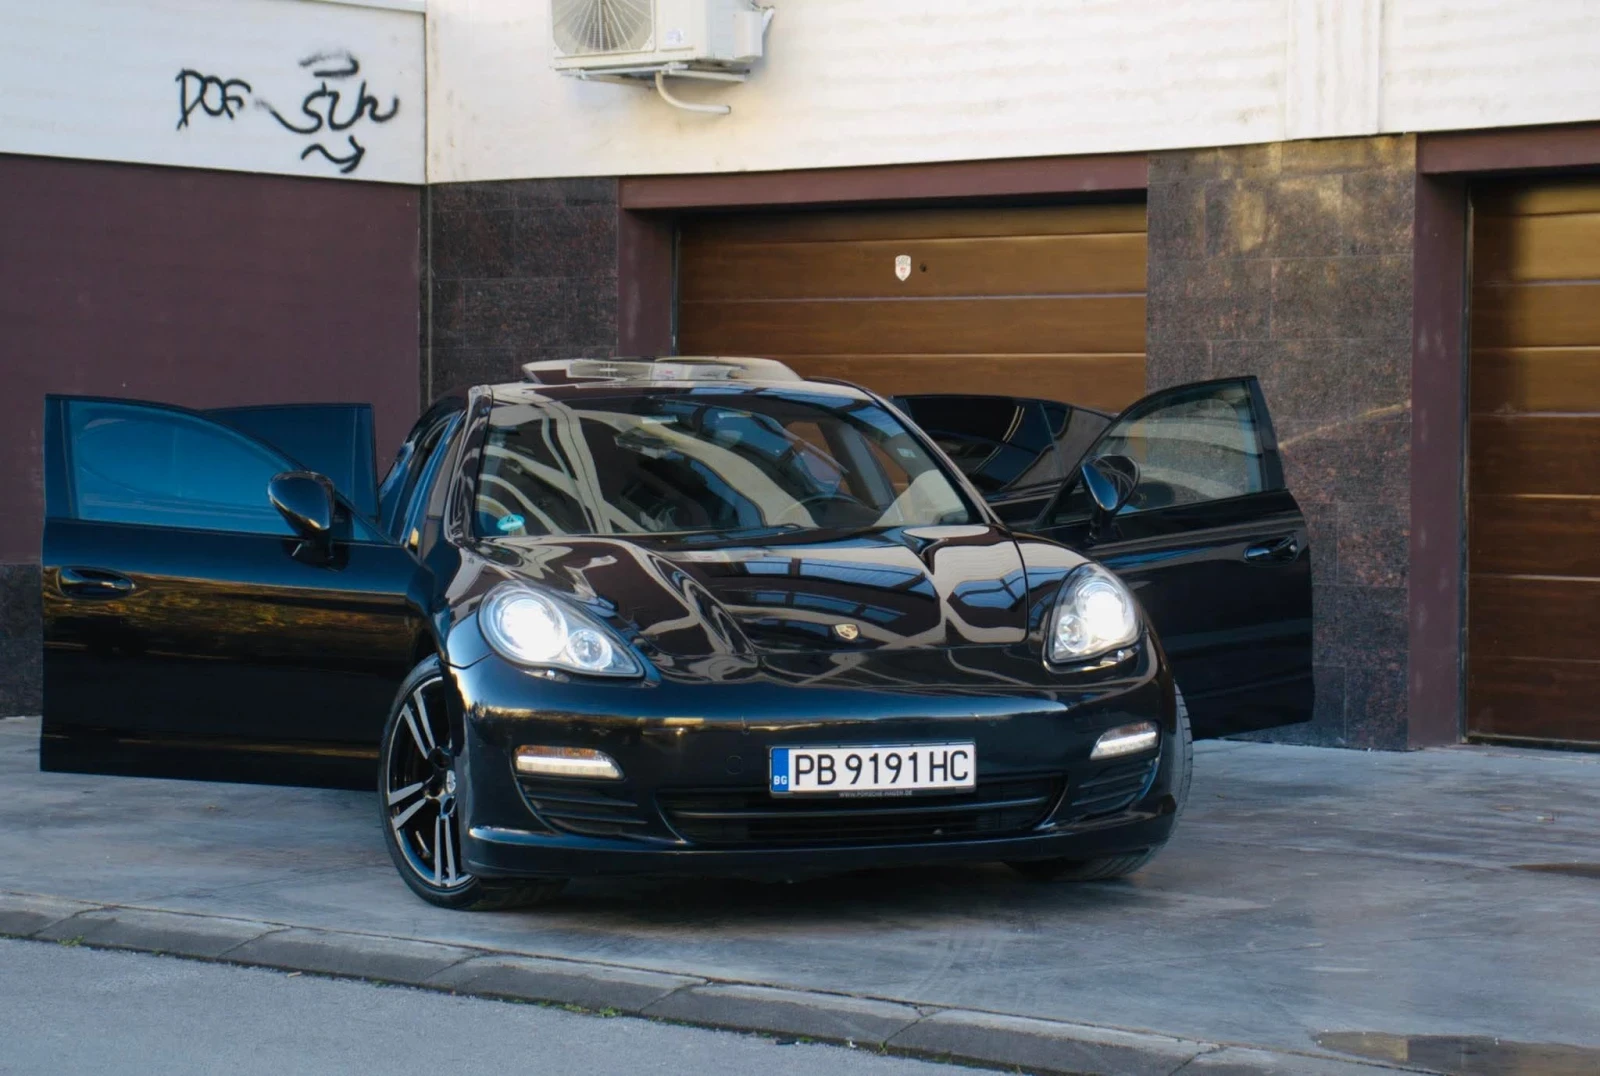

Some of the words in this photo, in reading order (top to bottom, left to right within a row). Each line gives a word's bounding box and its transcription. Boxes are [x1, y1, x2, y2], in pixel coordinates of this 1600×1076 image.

[795, 754, 837, 786] PB
[845, 752, 918, 785] 9191
[929, 750, 968, 782] HC
[773, 775, 788, 785] BG
